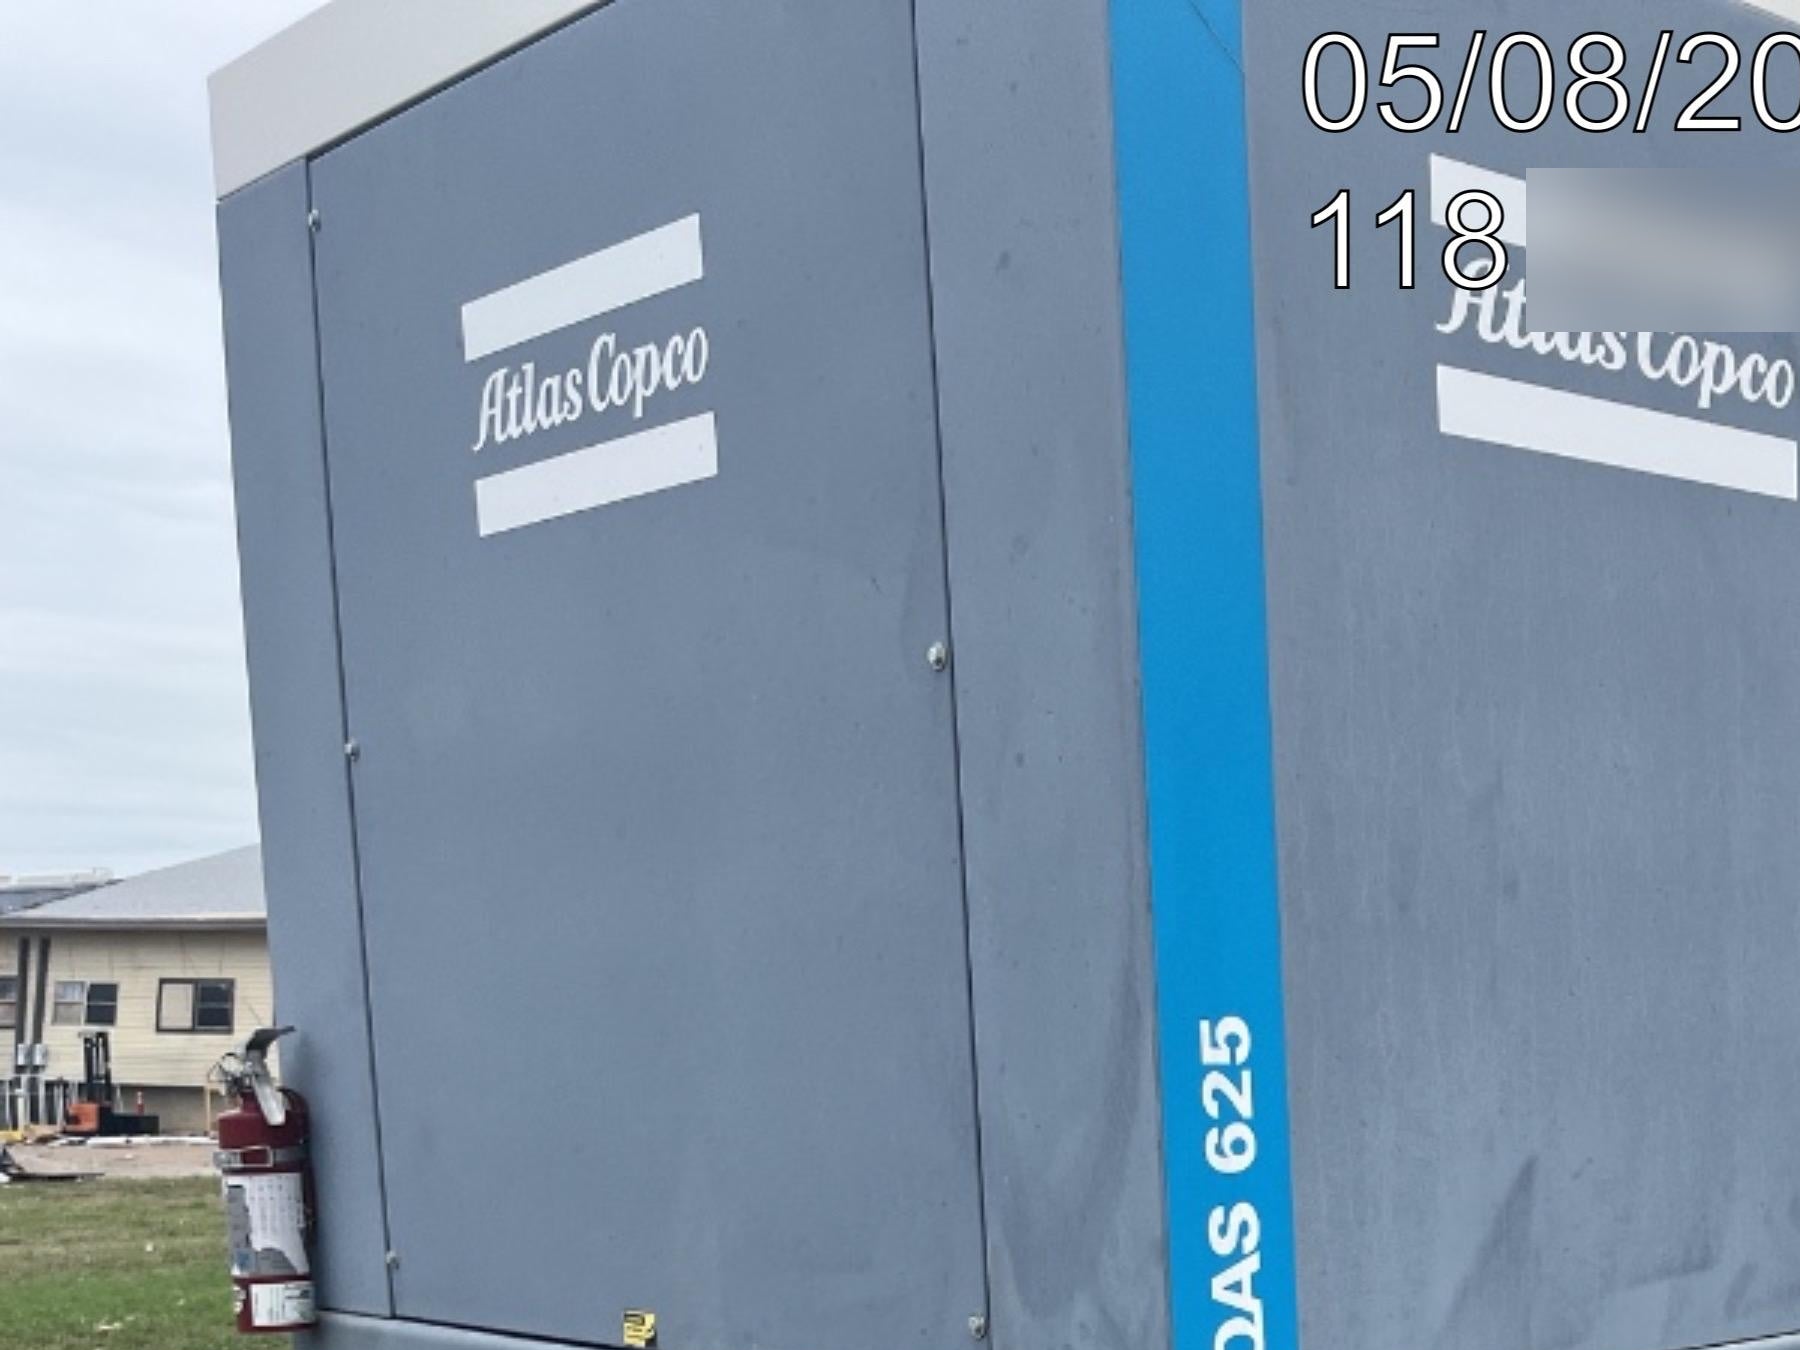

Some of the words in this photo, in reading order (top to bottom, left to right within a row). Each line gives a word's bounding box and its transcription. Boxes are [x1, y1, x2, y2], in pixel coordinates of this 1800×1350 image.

[472, 361, 583, 453] Atlas
[587, 325, 710, 419] Copco
[1200, 1015, 1257, 1174] 625
